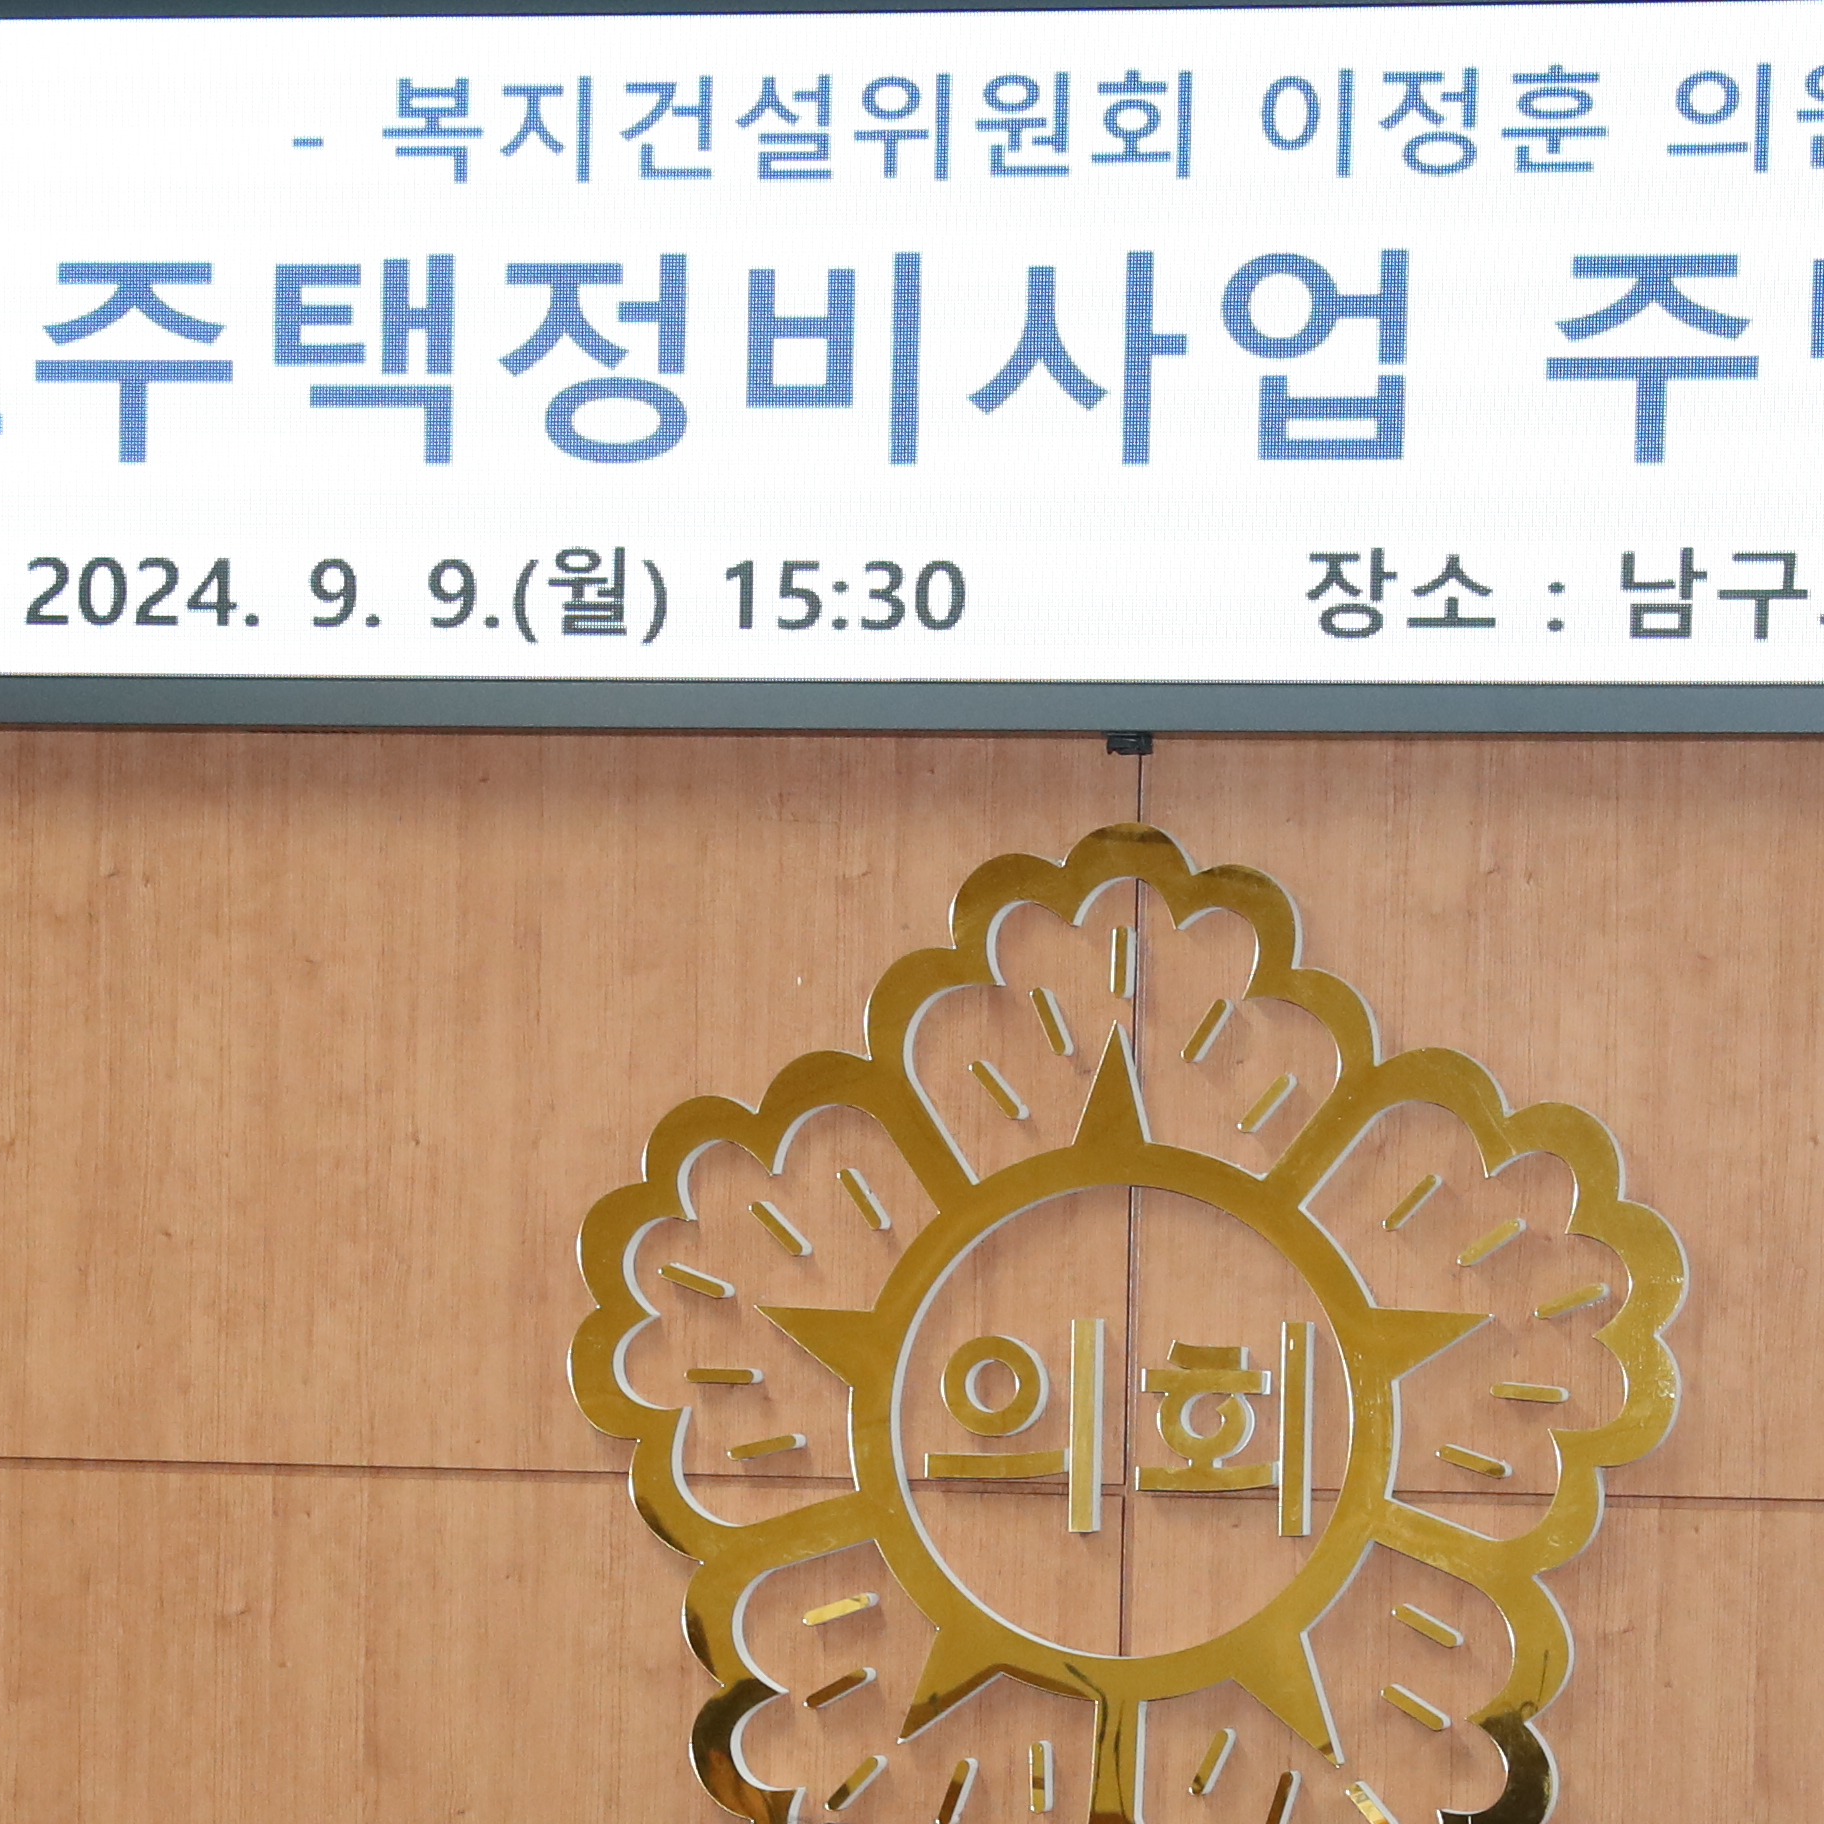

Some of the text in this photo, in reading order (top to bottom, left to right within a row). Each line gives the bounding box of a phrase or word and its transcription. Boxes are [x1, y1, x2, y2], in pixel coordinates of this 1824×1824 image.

[382, 70, 1193, 182] 복지건설위원회
[1261, 65, 1607, 177] 이정훈
[24, 556, 260, 629] 2024.
[309, 557, 381, 629] 9.
[427, 546, 668, 645] 9.(월)
[725, 559, 967, 632] 15:30
[1305, 546, 1497, 640] 장소
[925, 1317, 1317, 1538] 의회
